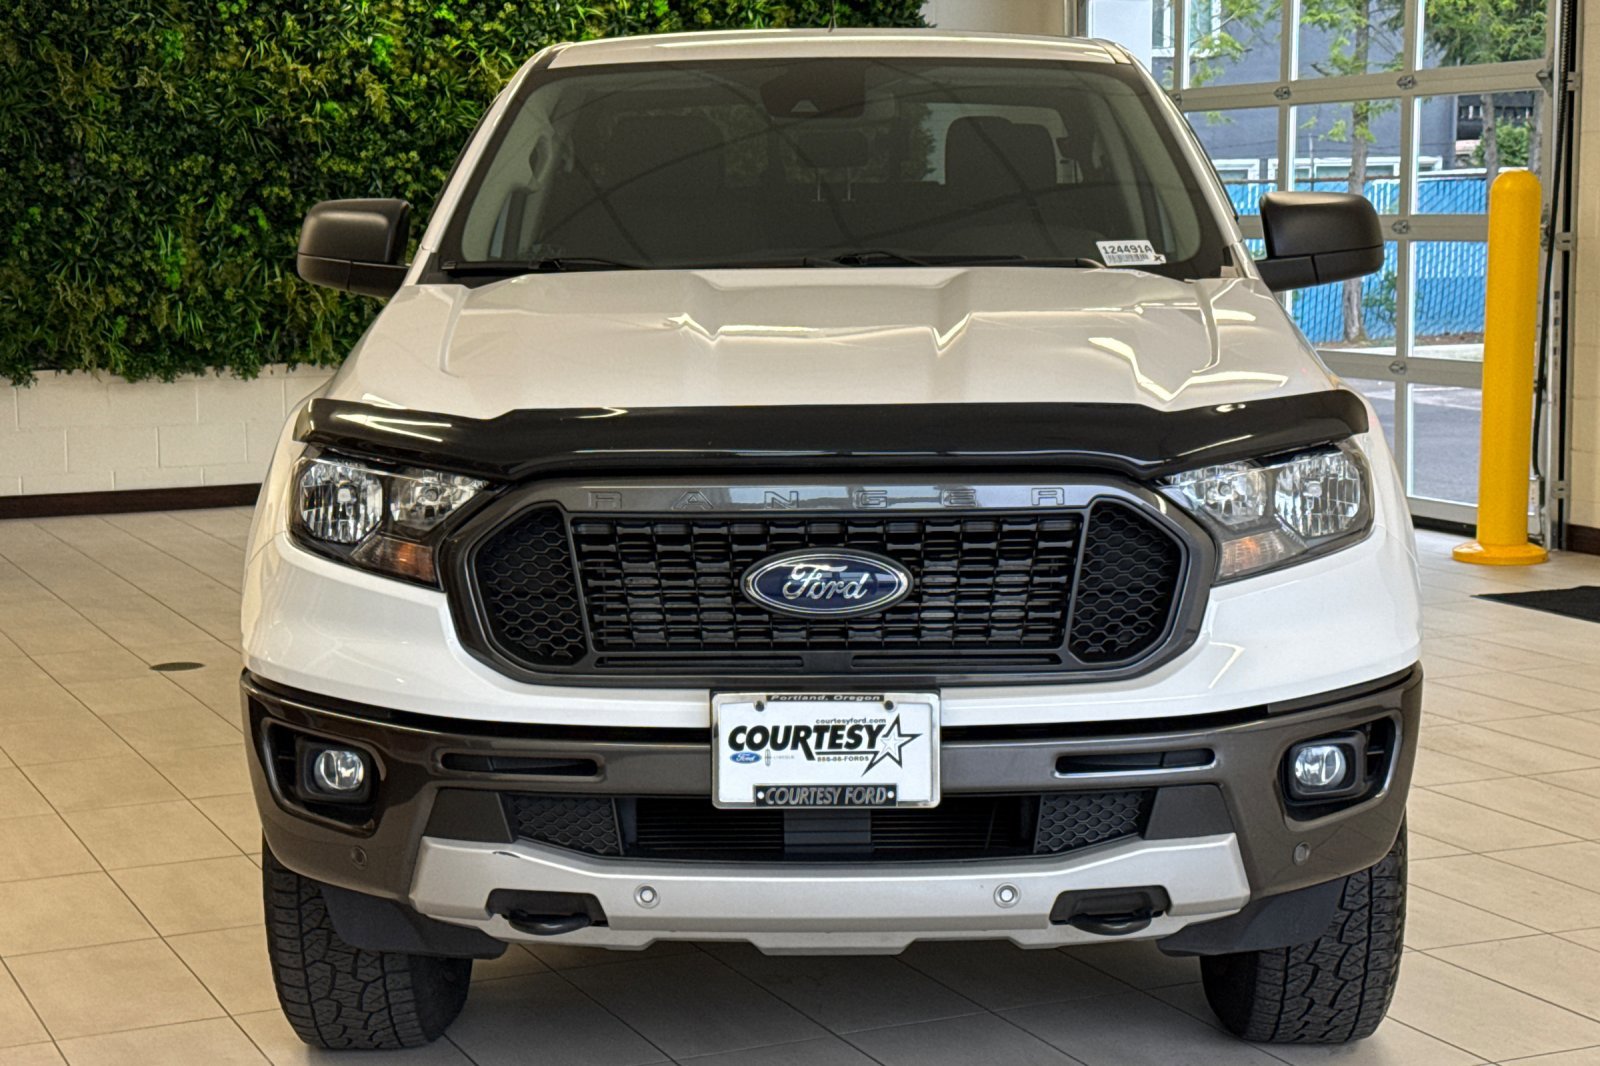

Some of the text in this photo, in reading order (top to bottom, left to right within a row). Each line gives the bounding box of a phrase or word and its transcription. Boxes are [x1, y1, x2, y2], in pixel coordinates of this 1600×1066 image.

[1102, 244, 1153, 255] 124491A
[588, 487, 1065, 510] RANGER
[782, 563, 869, 600] Ford
[833, 694, 880, 702] Oregon
[728, 725, 887, 761] COURTESY
[736, 753, 756, 763] Ford
[766, 787, 886, 805] COURTESY FORD
